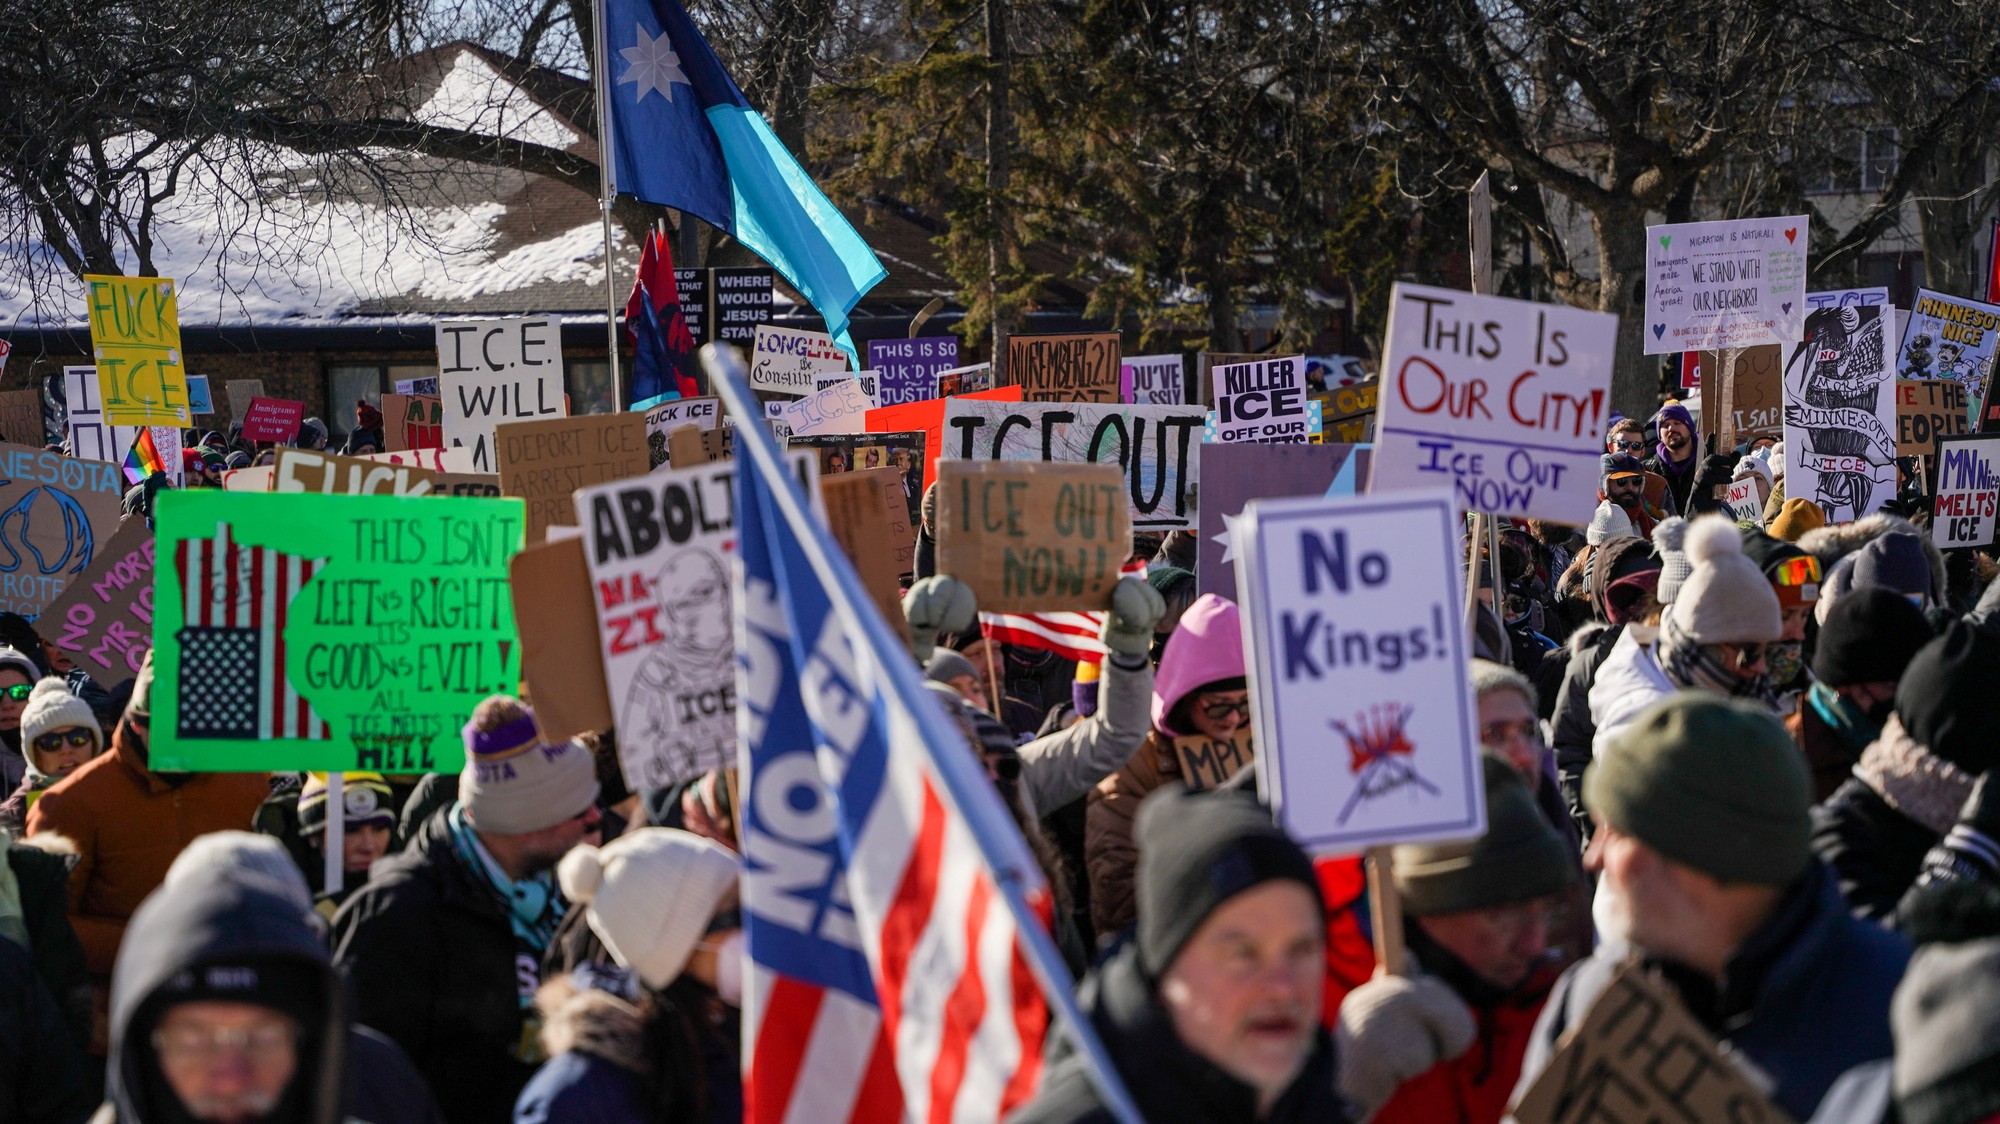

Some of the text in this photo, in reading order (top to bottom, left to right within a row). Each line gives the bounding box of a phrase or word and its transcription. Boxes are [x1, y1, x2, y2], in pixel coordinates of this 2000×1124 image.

[1689, 229, 1775, 248] MIGRATION IS NATURAL!
[683, 271, 696, 279] OF
[1654, 256, 1689, 271] Immigrants
[1692, 262, 1707, 284] WE
[1709, 260, 1736, 283] STAND
[1738, 258, 1761, 280] WITH
[681, 282, 703, 290] THAT
[718, 293, 772, 304] WOULD
[719, 276, 772, 287] WHERE
[1653, 284, 1684, 299] America
[1692, 287, 1758, 311] OUR NEIGHBORS!
[90, 281, 179, 342] FUCK
[685, 304, 703, 312] ARE
[722, 310, 769, 321] JESUS
[1659, 296, 1684, 313] great!
[758, 332, 807, 357] LONG
[1403, 293, 1570, 367] THIS IS
[1942, 322, 1983, 348] NICE
[442, 322, 552, 374] I.C.E.
[873, 341, 957, 359] THIS IS SO
[1819, 350, 1836, 360] NO
[99, 359, 185, 409] ICE
[1224, 360, 1295, 396] KILLER
[1816, 377, 1865, 392] MORE
[254, 403, 296, 415] Immigrants
[458, 377, 557, 419] WILL
[787, 381, 863, 434] ICE
[1219, 387, 1304, 424] ICE
[1399, 355, 1606, 438] OUR CITY!
[1921, 381, 1969, 411] THE
[258, 425, 275, 434] here
[263, 416, 293, 425] welcome
[645, 404, 713, 426] FUCK ICE
[1221, 427, 1260, 441] OFF
[1262, 421, 1305, 436] OUR
[1799, 408, 1890, 452] MINNESOTA
[507, 424, 640, 465] DEPORT ICE.
[511, 464, 586, 498] ARREST
[593, 458, 640, 482] THE
[1087, 412, 1206, 517] OUT
[1419, 441, 1568, 491] ICE OUT
[1812, 458, 1866, 472] NICE
[1942, 449, 2000, 490] MN Nice
[961, 477, 1121, 542] ICE OUT
[1456, 476, 1535, 514] NOW
[1935, 491, 1996, 518] MELTS
[350, 513, 517, 568] THIS ISN'T
[1948, 516, 1980, 542] ICE
[1002, 545, 1108, 598] NOW!
[1299, 527, 1391, 596] No
[56, 603, 96, 651] NO
[92, 538, 154, 603] MORE
[313, 579, 381, 627] LEFT
[409, 576, 511, 630] RIGHT
[88, 620, 140, 669] MR
[374, 620, 411, 646] ITS
[604, 605, 667, 659] ZI
[1280, 603, 1449, 681] Kings!
[304, 642, 384, 691] GOOD
[417, 640, 513, 695] EVIL!
[369, 689, 411, 713] ALL
[674, 687, 737, 725] ICE
[355, 735, 436, 770] HELL
[742, 751, 839, 933] NO
